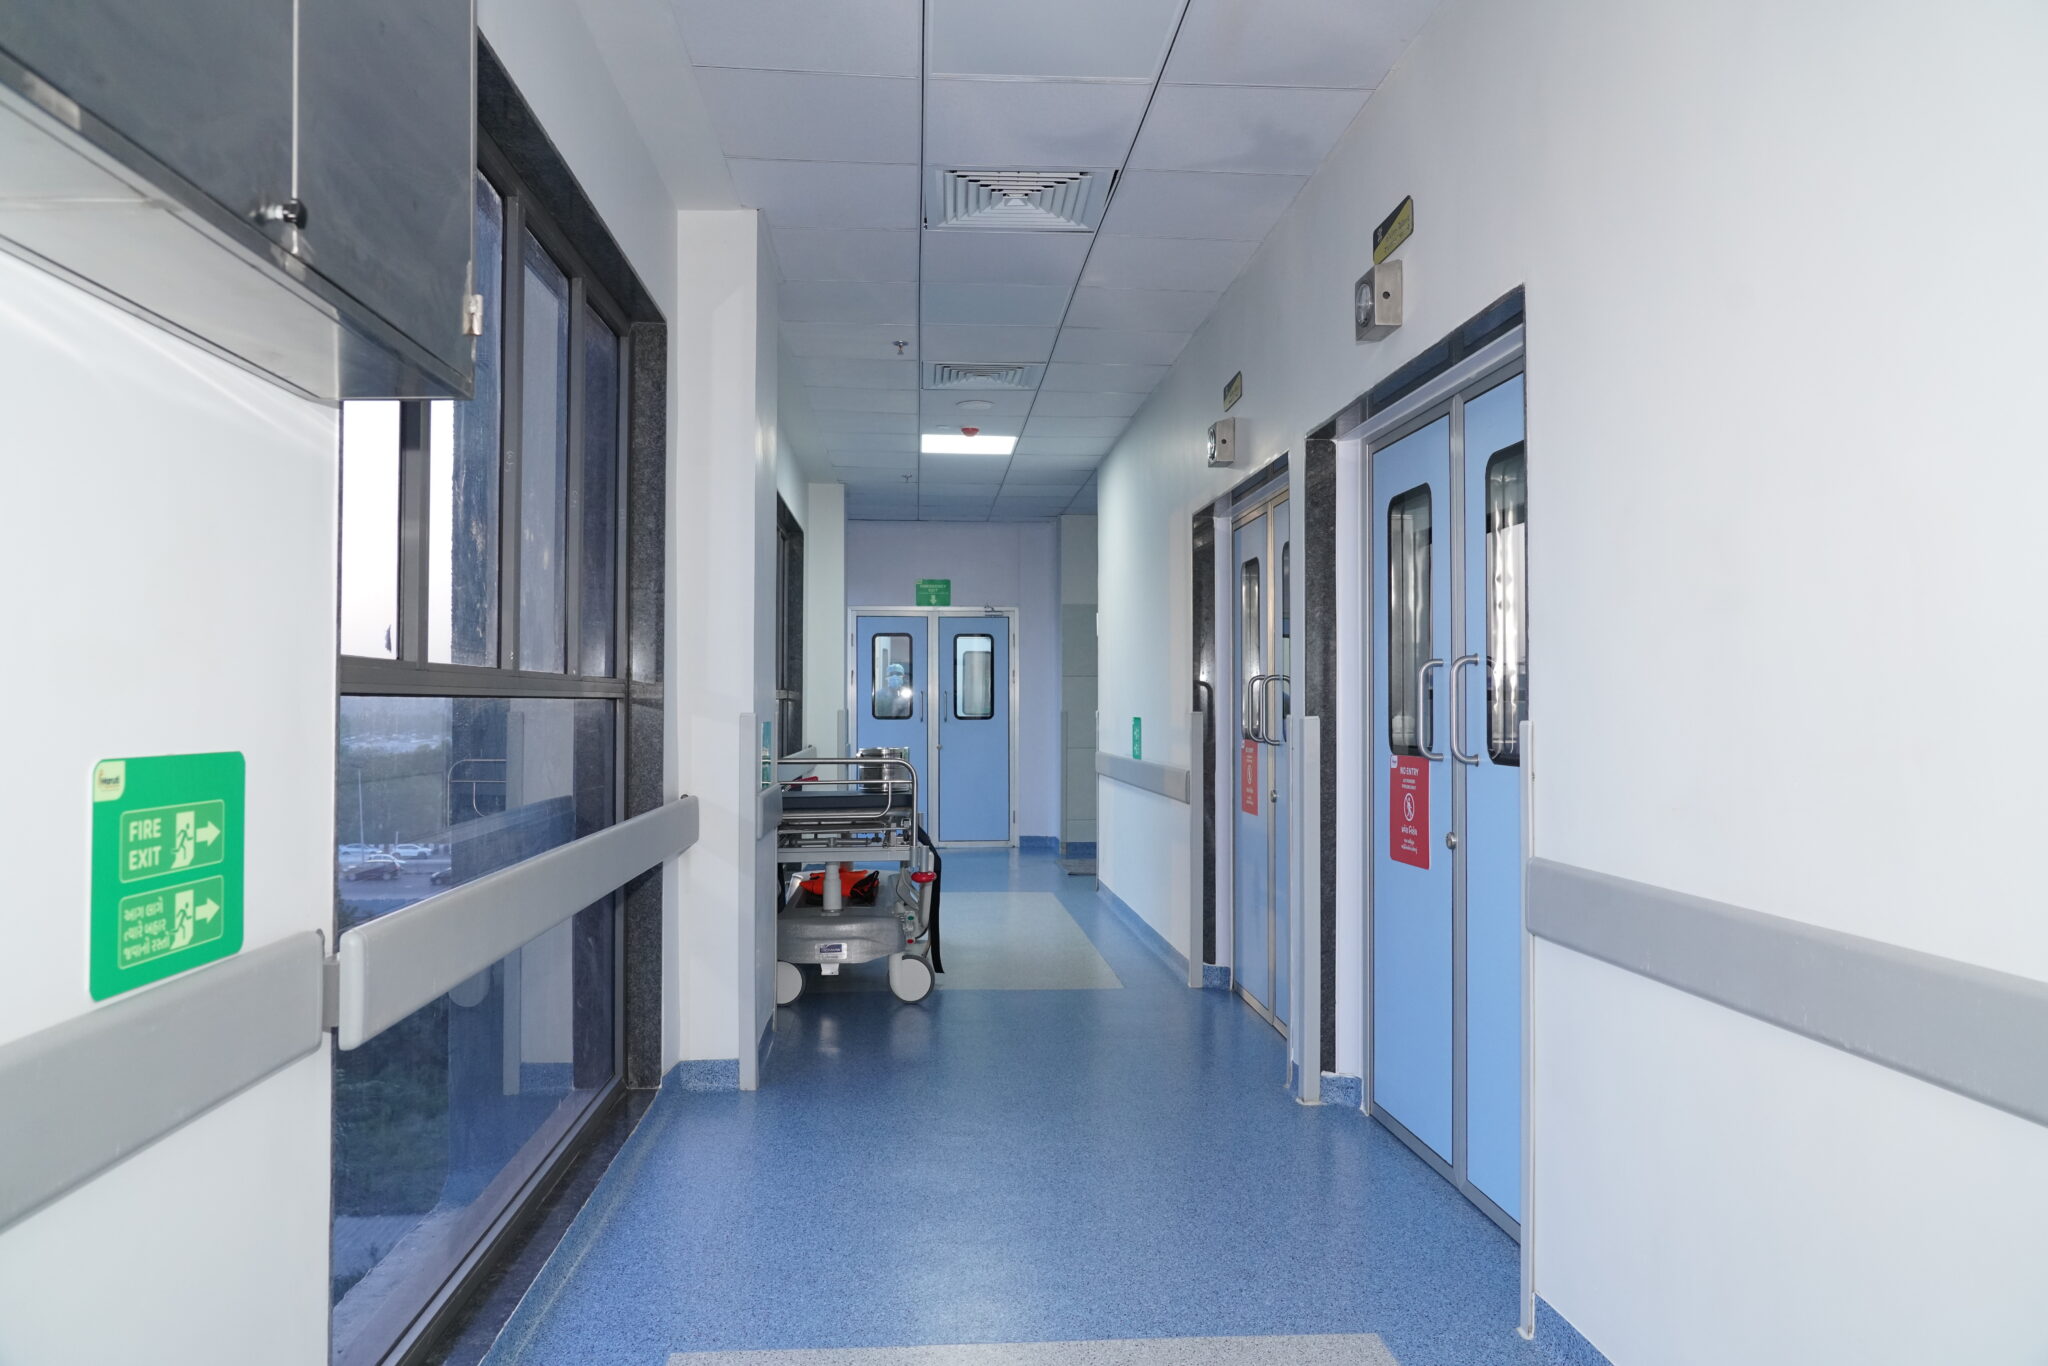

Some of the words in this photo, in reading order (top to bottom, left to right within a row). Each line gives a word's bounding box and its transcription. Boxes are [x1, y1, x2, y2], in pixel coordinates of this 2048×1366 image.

[1400, 766, 1406, 775] NO
[1406, 767, 1419, 776] ENTRY
[129, 818, 161, 842] FIRE
[129, 846, 162, 870] EXIT
